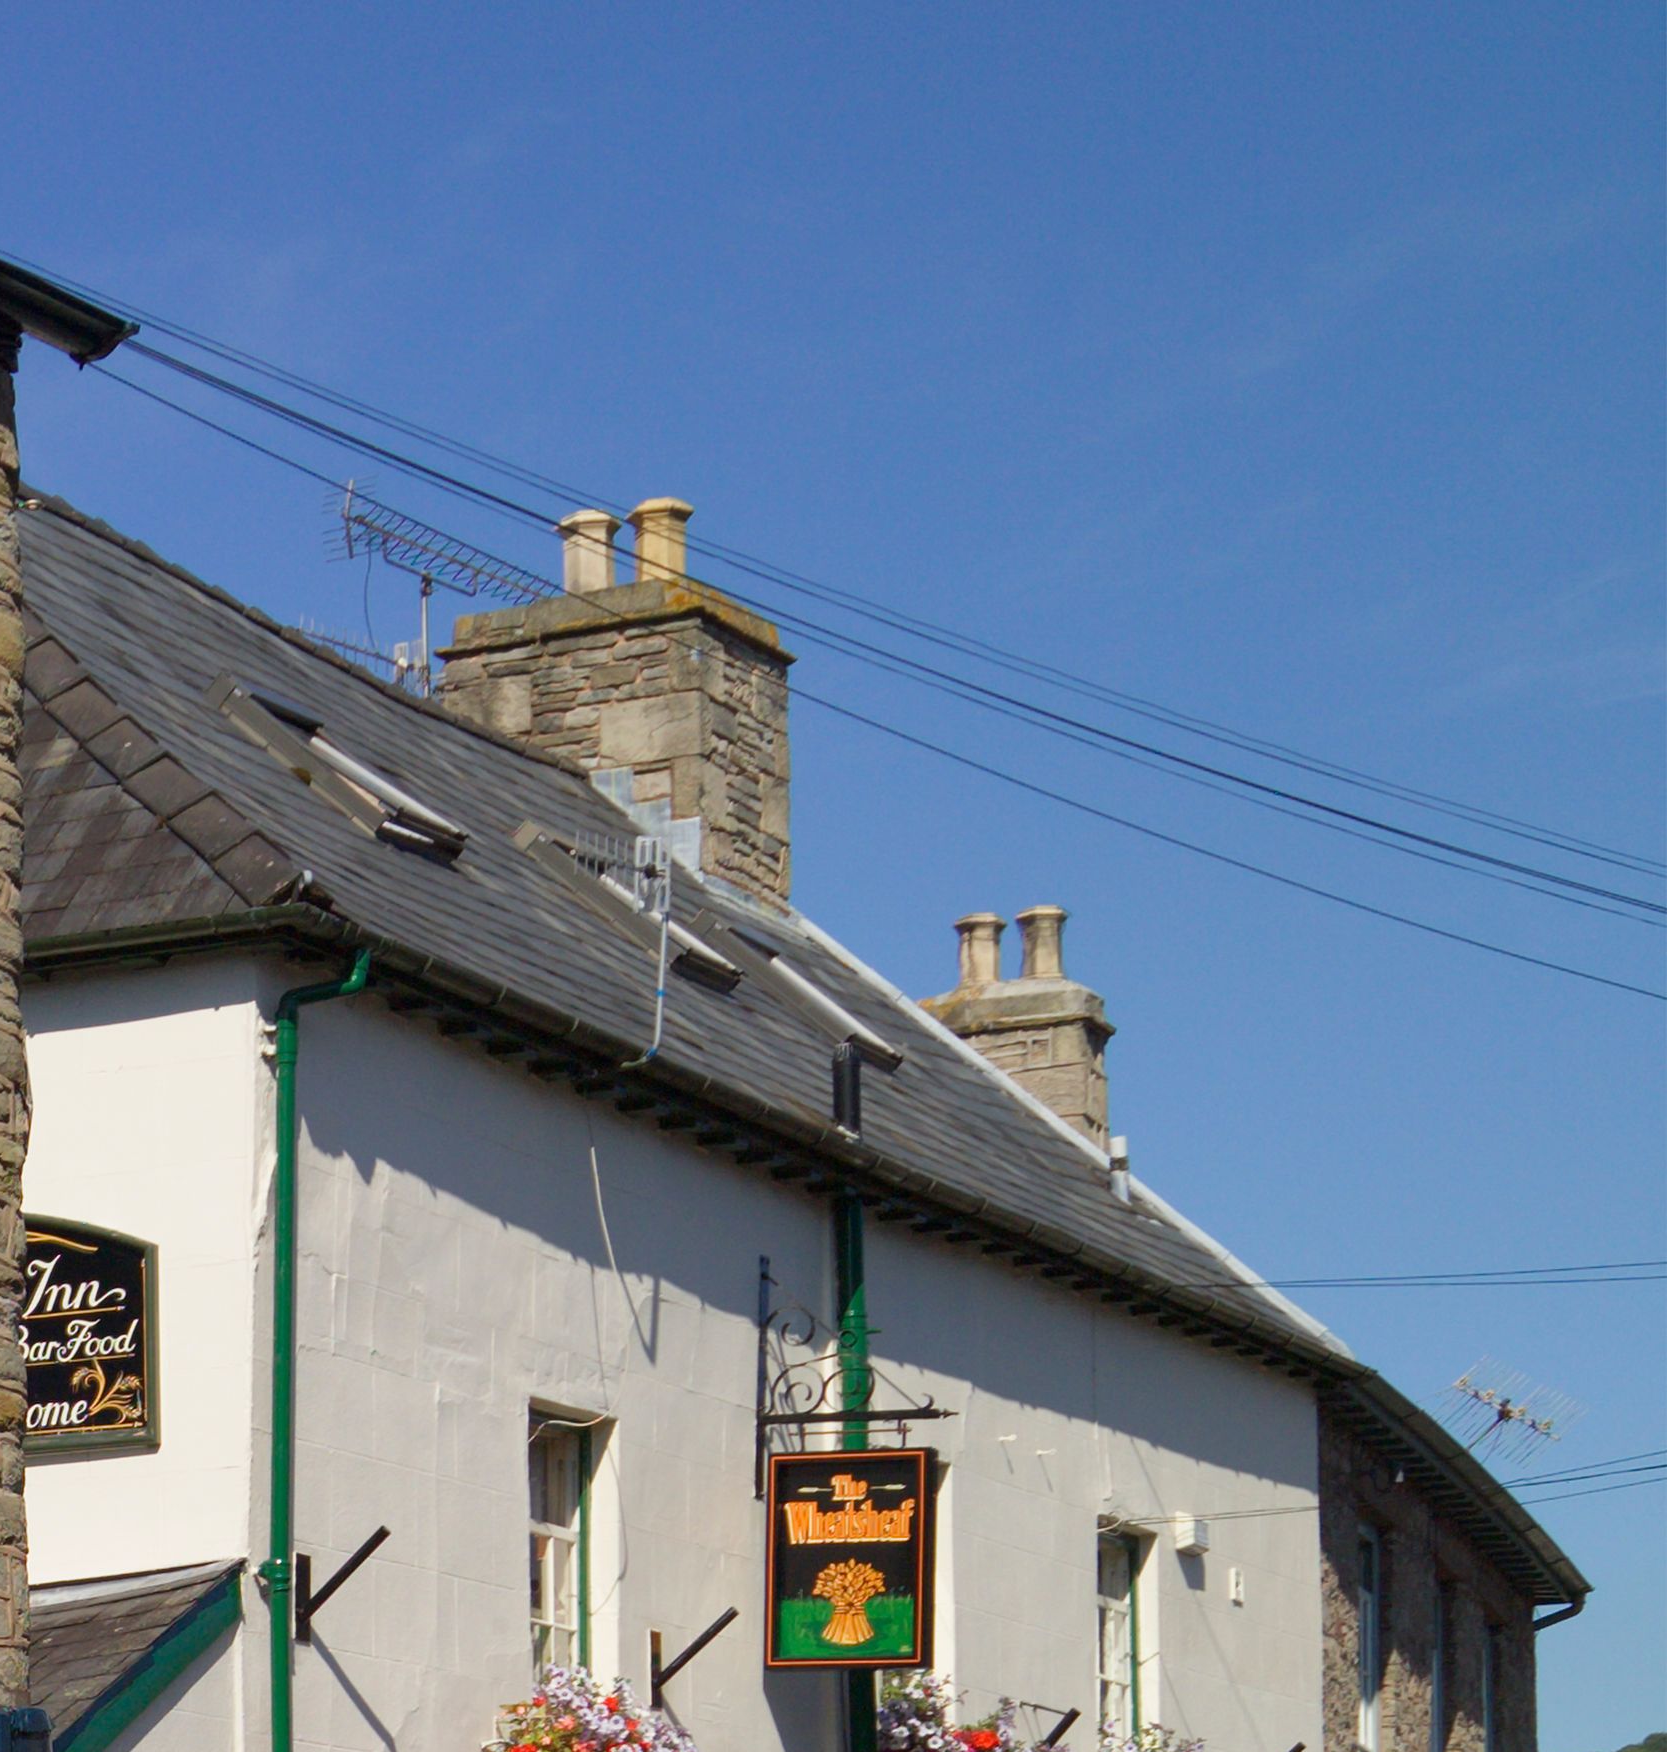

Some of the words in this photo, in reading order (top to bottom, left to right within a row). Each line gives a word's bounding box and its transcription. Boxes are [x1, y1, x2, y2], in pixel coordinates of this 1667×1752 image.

[22, 1254, 127, 1318] Inn
[57, 1318, 140, 1363] Food
[830, 1474, 868, 1500] The
[784, 1499, 916, 1545] Wheatsheaf
